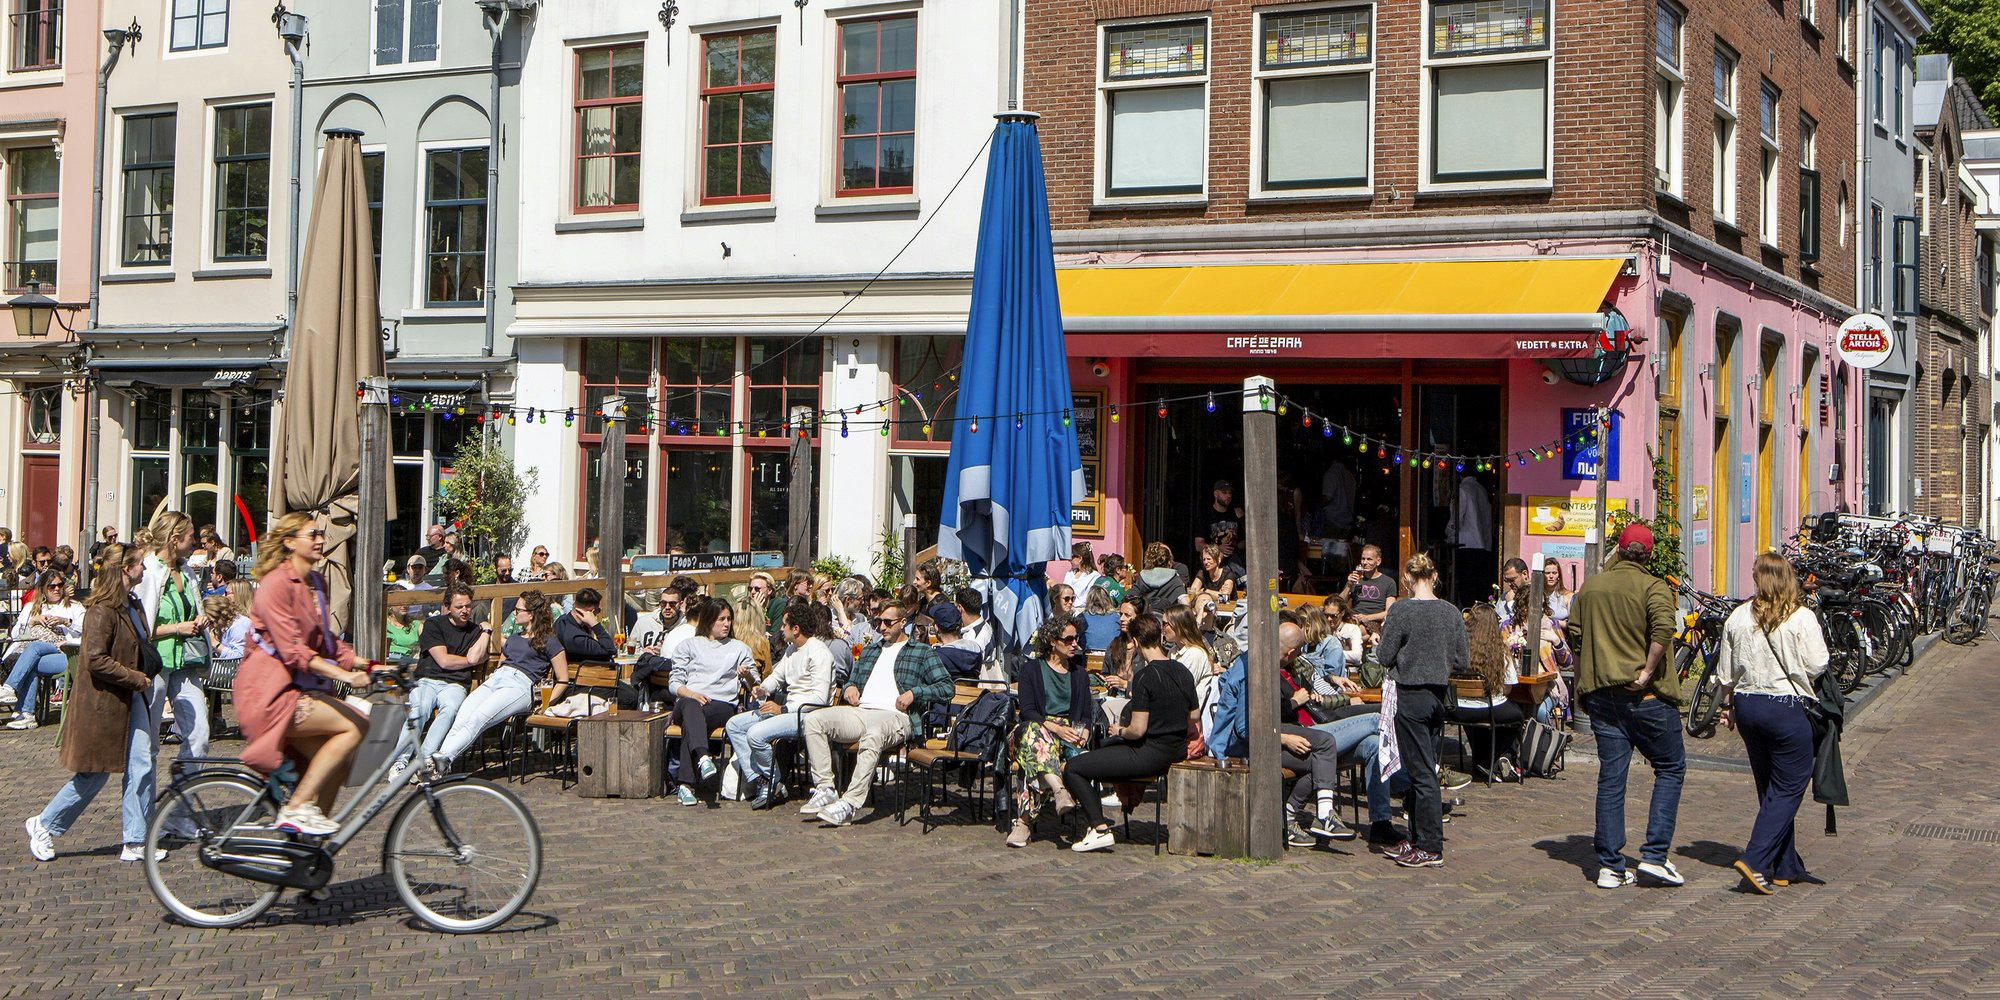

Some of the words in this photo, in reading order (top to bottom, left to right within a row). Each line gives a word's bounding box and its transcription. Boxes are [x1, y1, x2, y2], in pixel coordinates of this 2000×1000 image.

[1227, 334, 1257, 348] CAFÉ
[1848, 333, 1880, 341] STELLA
[1516, 340, 1549, 349] VEDETT
[1558, 340, 1588, 349] EXTRA
[1848, 340, 1881, 348] ARTOIS
[672, 555, 697, 569] FOOD?
[713, 555, 730, 567] YOUR
[731, 554, 748, 567] OWN!
